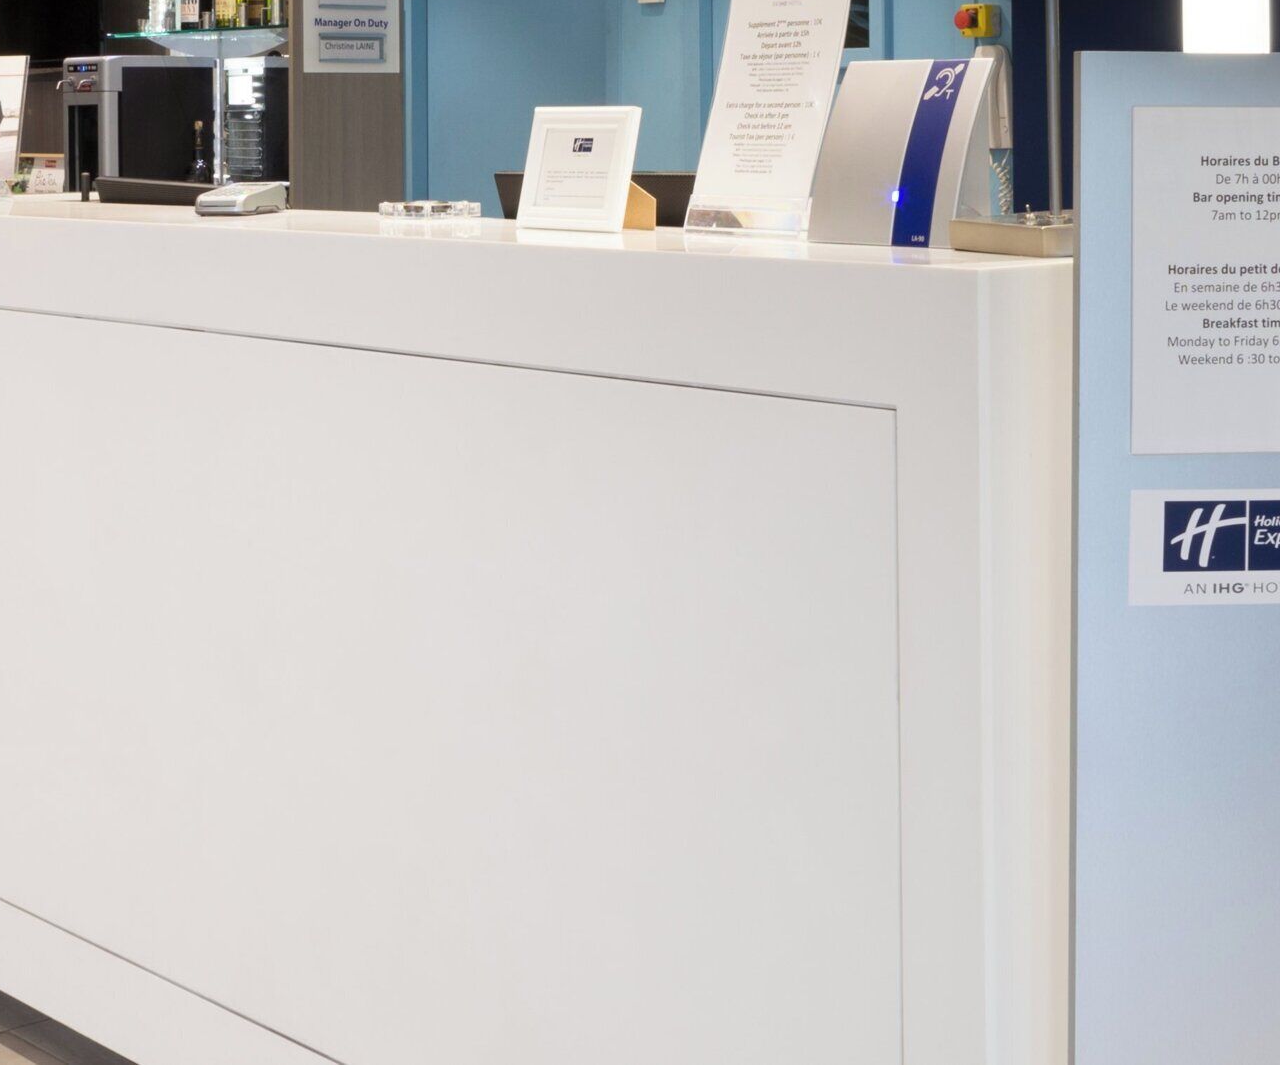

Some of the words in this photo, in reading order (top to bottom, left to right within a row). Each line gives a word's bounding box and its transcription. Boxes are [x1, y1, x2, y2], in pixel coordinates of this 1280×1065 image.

[315, 18, 351, 29] Manager
[354, 19, 366, 27] On
[368, 19, 388, 29] Duty
[325, 42, 354, 50] Christine
[1200, 155, 1251, 167] Horaires
[1253, 155, 1269, 167] du
[1215, 173, 1232, 185] De
[1234, 173, 1249, 185] 7h
[1252, 172, 1259, 185] à
[1192, 191, 1213, 203] Bar
[1216, 191, 1264, 206] opening
[1211, 209, 1237, 221] 7am
[1239, 210, 1252, 221] to
[1167, 262, 1218, 275] Horaires
[1221, 262, 1236, 275] du
[1239, 263, 1268, 277] petit
[1173, 282, 1188, 294] En
[1191, 281, 1240, 294] semaine
[1242, 281, 1258, 293] de
[1165, 300, 1178, 312] Le
[1180, 299, 1234, 312] weekend
[1236, 299, 1252, 311] de
[1202, 316, 1259, 329] Breakfast
[1167, 335, 1216, 350] Monday
[1218, 337, 1231, 347] to
[1233, 334, 1270, 349] Friday
[1177, 353, 1234, 366] Weekend
[1236, 353, 1245, 365] 6
[1247, 353, 1266, 365] :30
[1268, 354, 1280, 365] to
[1184, 583, 1208, 594] AN
[1212, 582, 1245, 594] IHG
